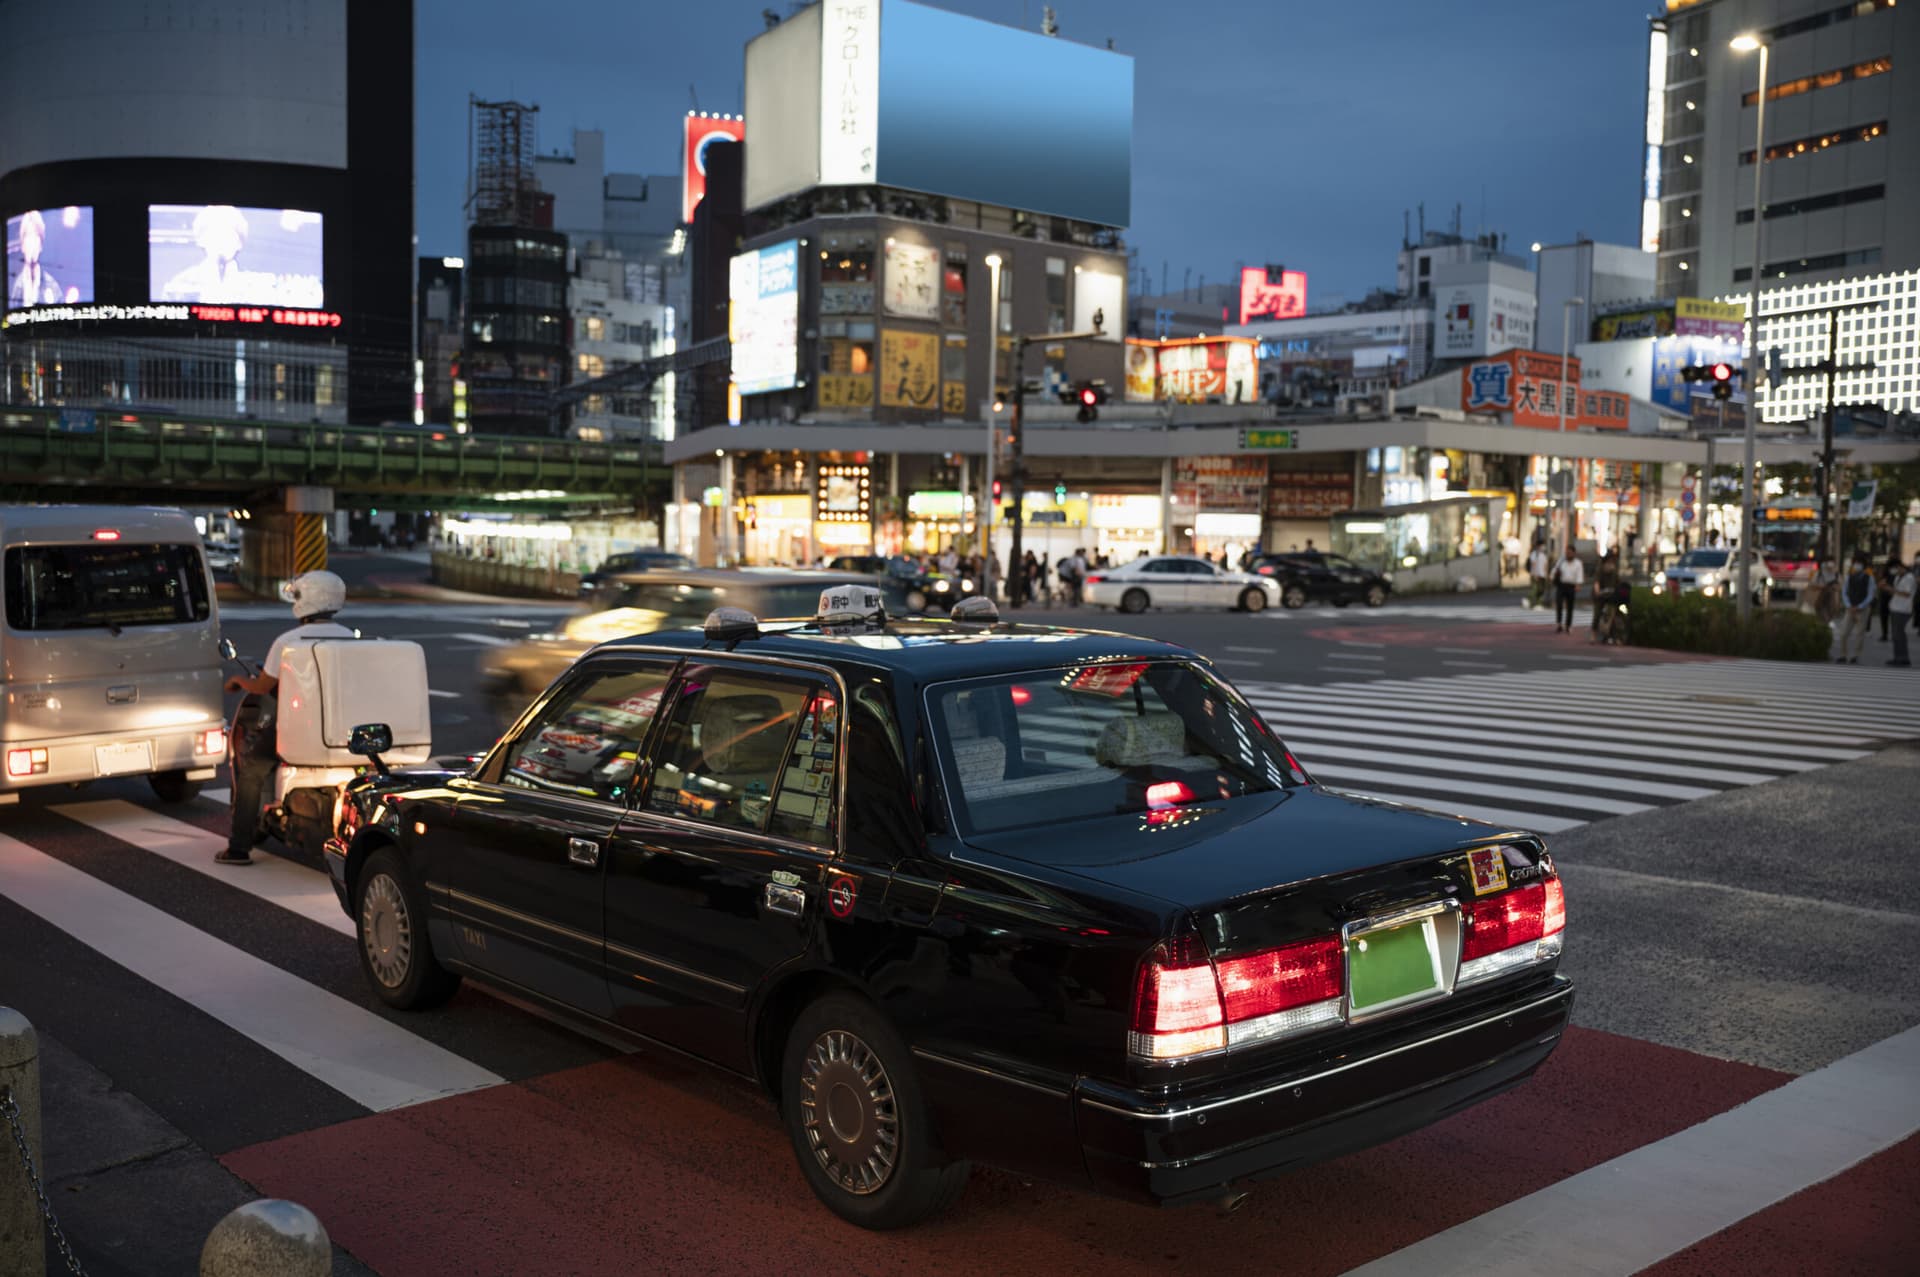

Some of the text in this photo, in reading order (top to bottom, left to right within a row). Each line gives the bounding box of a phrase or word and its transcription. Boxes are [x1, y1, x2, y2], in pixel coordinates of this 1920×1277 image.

[835, 6, 867, 20] THE
[1469, 363, 1511, 406] 質
[832, 595, 849, 609] 府中
